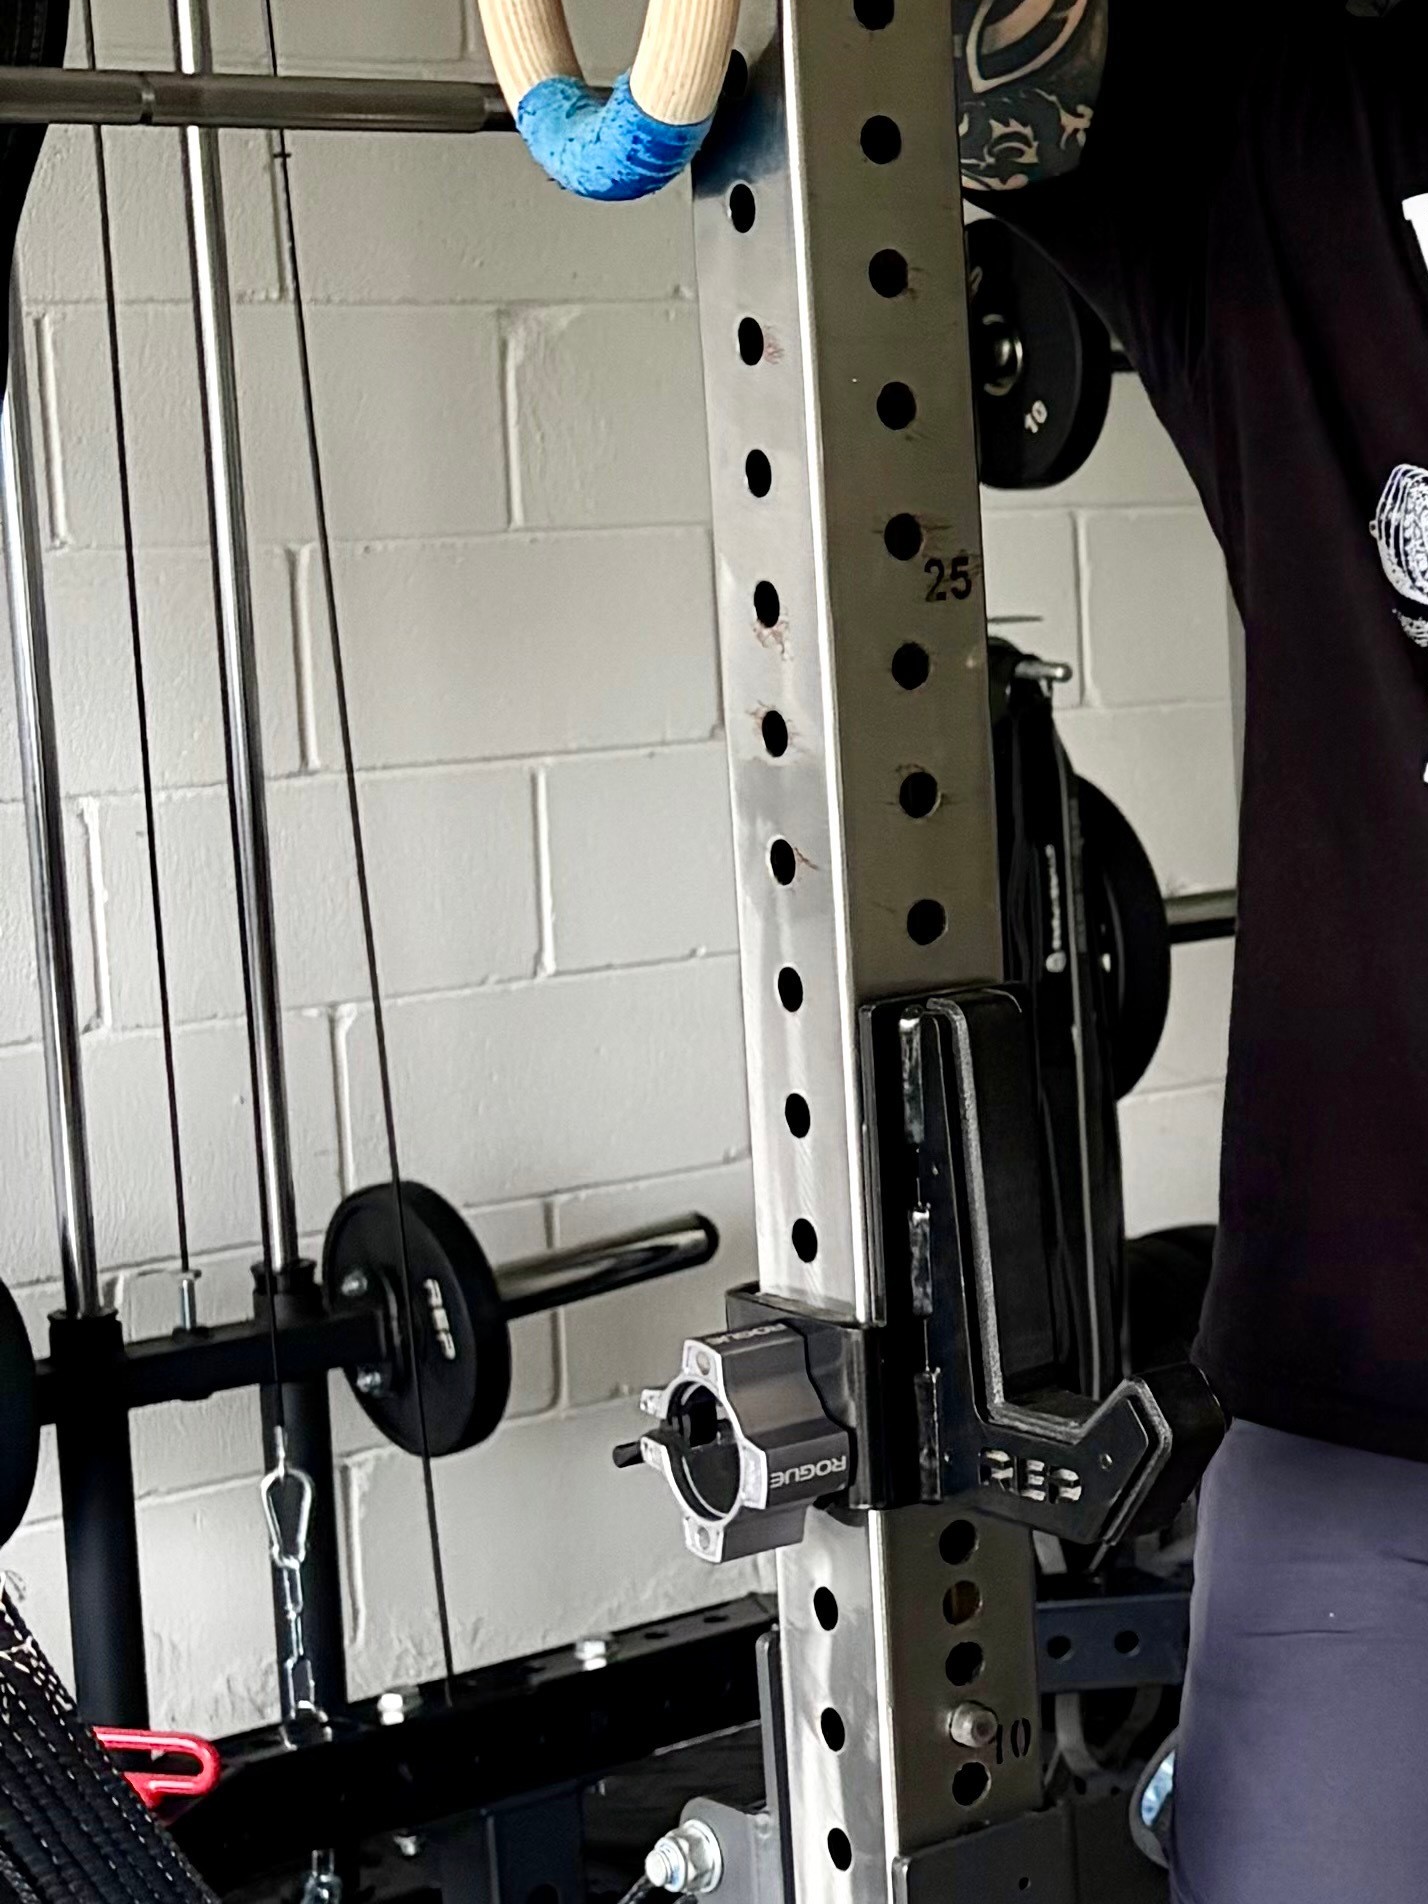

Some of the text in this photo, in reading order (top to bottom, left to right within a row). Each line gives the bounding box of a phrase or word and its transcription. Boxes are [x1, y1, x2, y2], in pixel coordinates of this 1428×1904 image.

[1024, 400, 1048, 434] 10
[923, 555, 972, 603] 25
[770, 1455, 847, 1489] ROGUE
[980, 1446, 1082, 1504] REP
[996, 1717, 1031, 1765] 10
